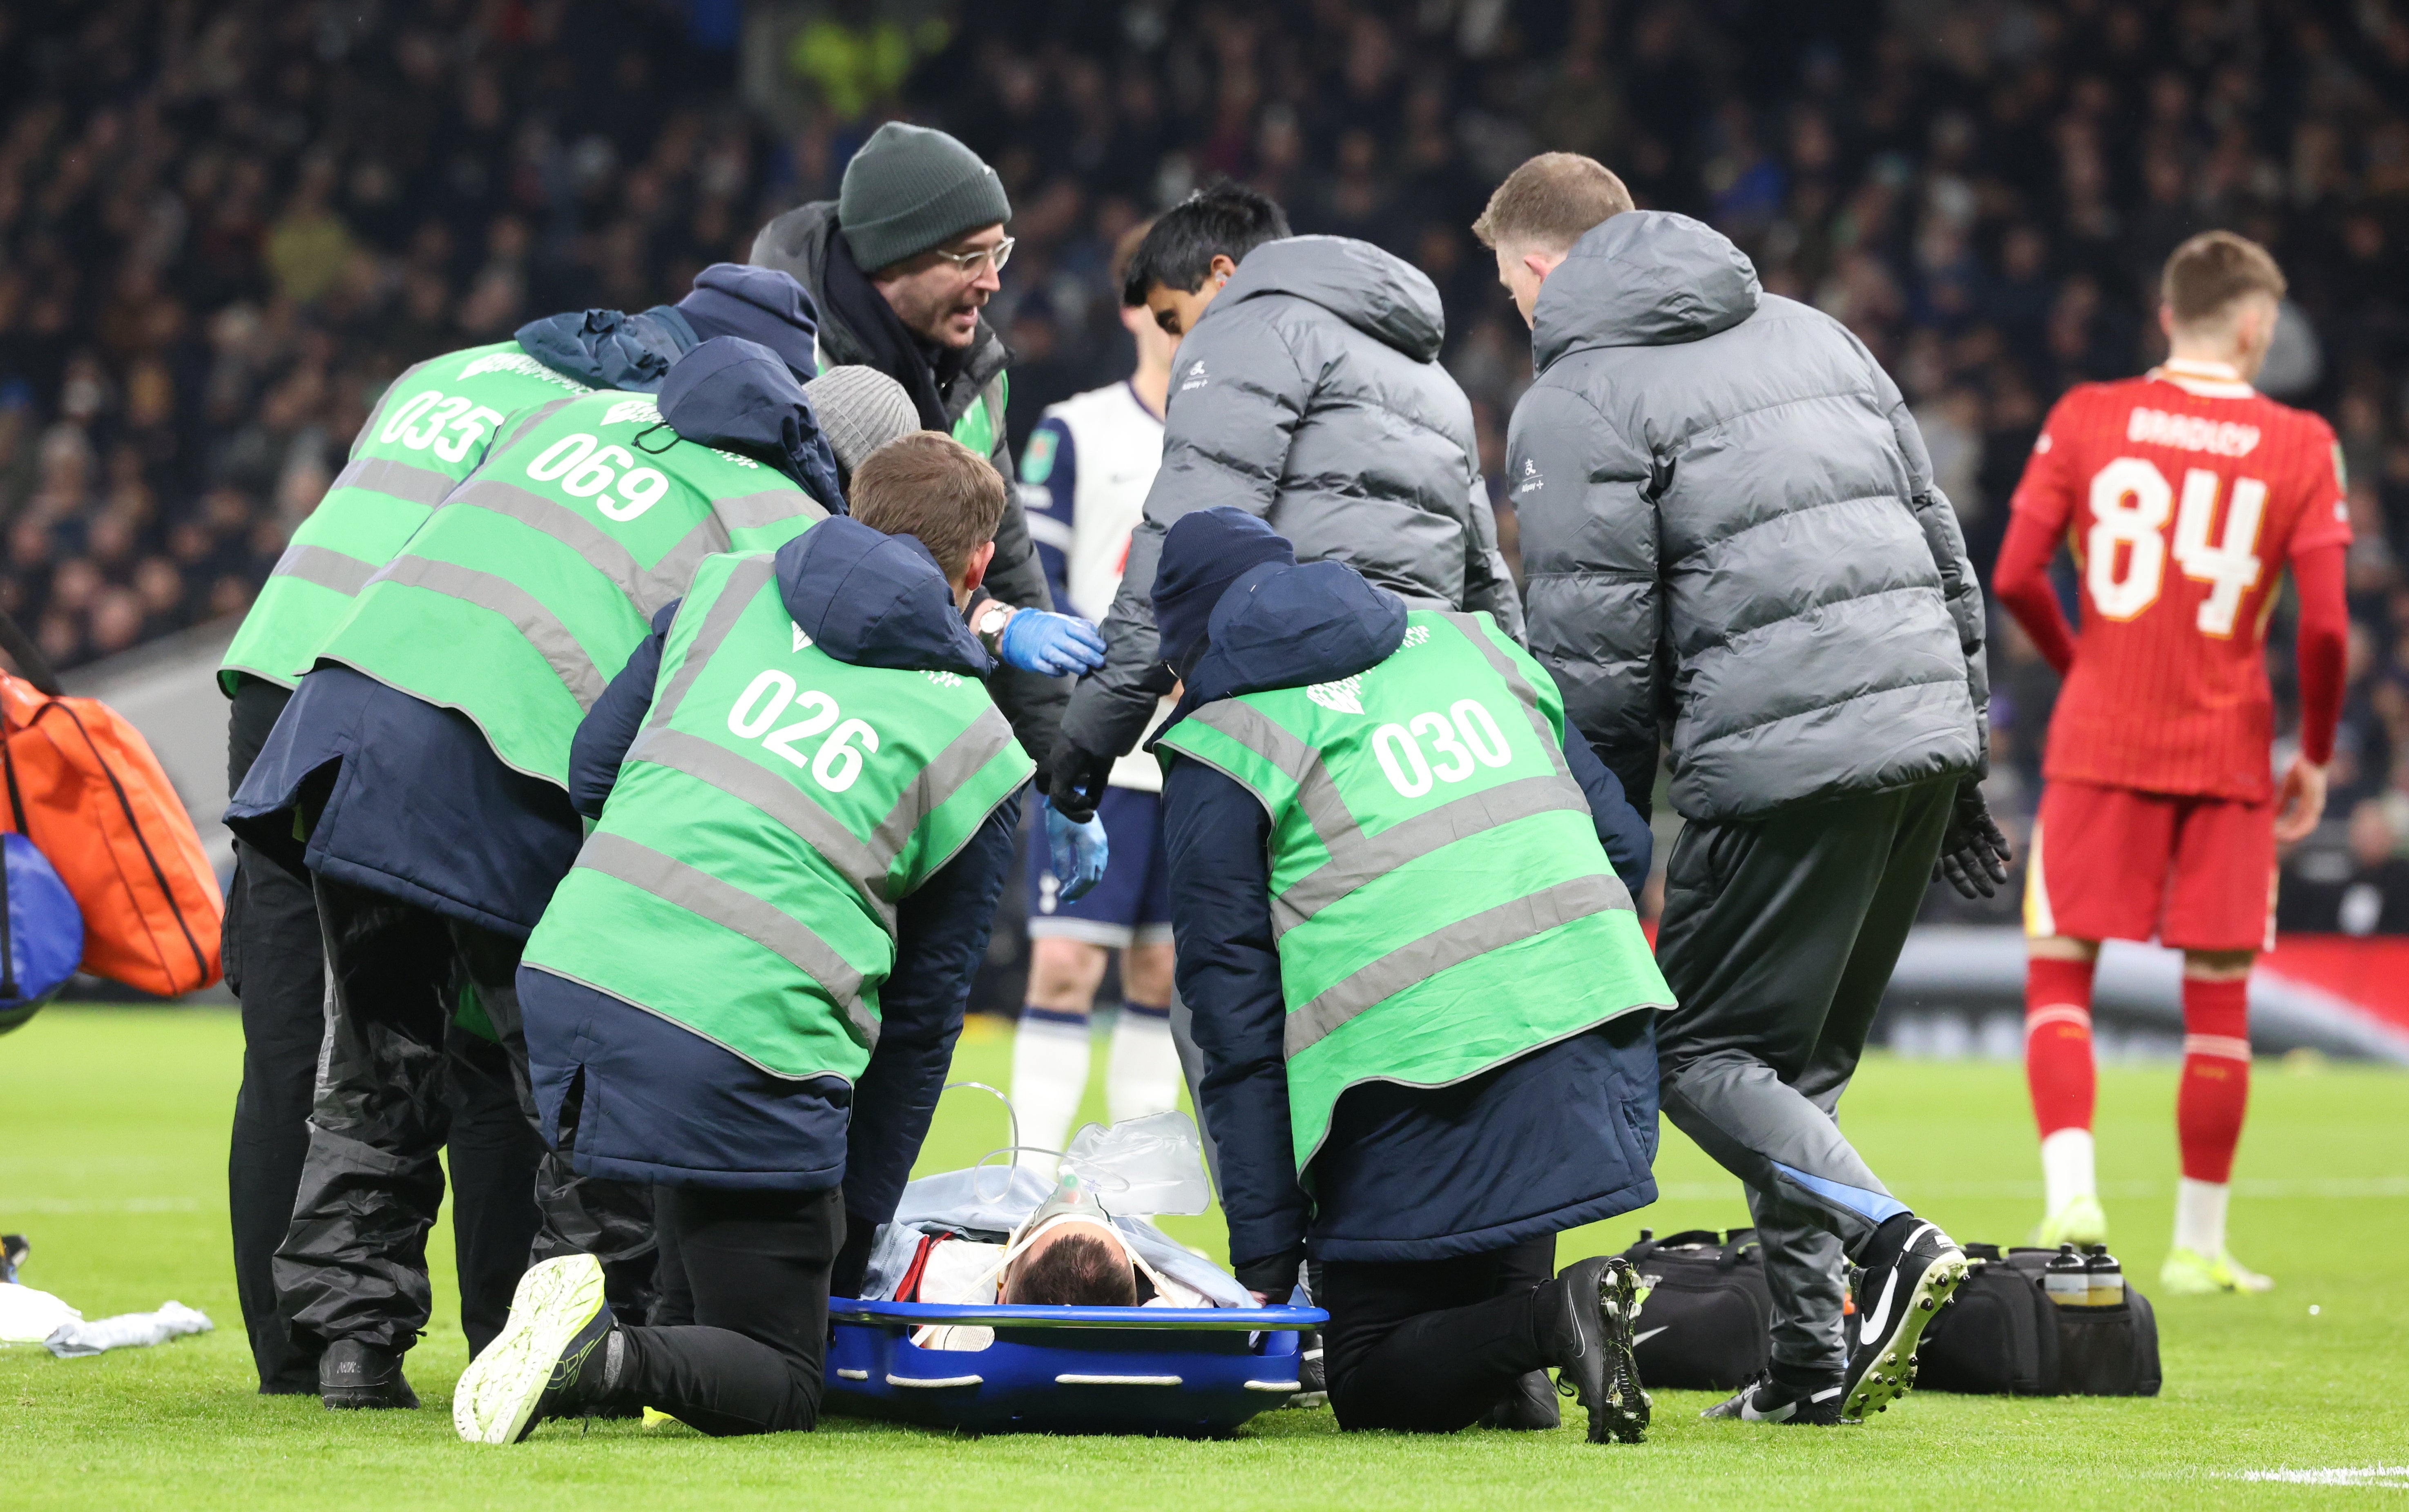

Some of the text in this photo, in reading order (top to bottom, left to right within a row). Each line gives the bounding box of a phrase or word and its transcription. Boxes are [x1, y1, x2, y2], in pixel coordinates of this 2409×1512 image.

[379, 390, 505, 463] 035
[2126, 407, 2261, 458] BRADLEY
[526, 433, 669, 522] 069
[2088, 457, 2269, 639] 84
[727, 669, 880, 792] 026
[1371, 698, 1513, 798] 030
